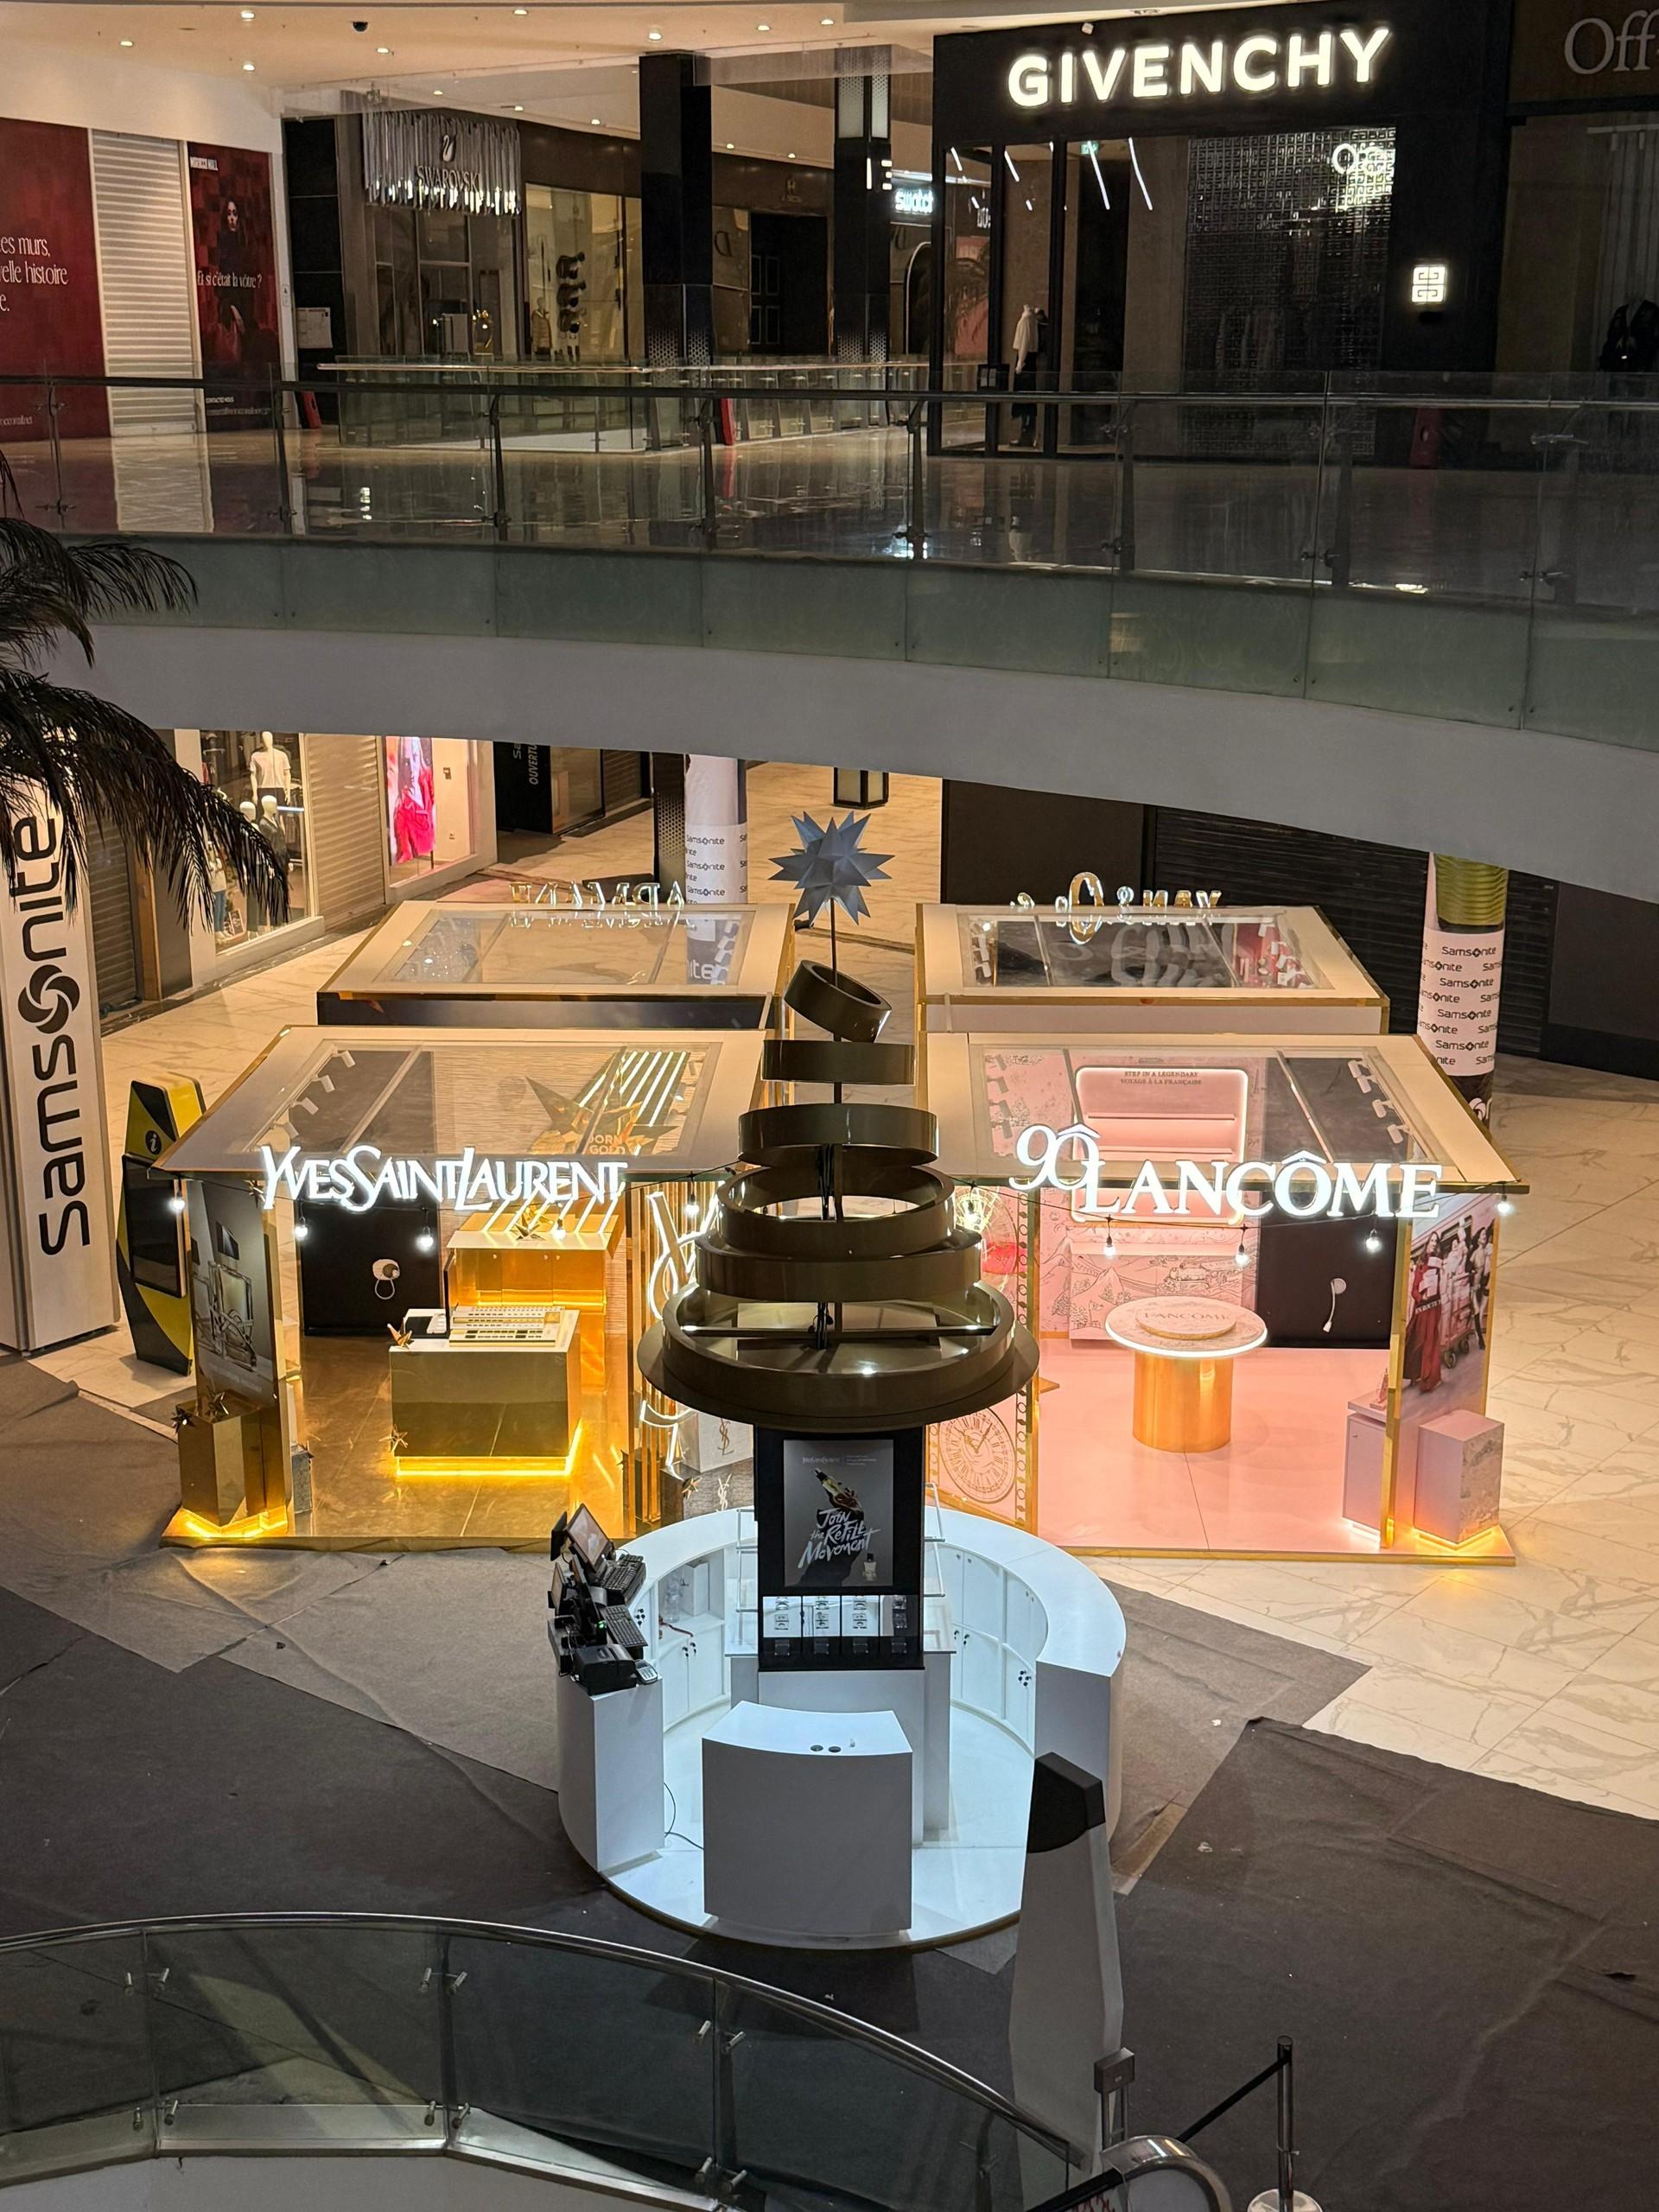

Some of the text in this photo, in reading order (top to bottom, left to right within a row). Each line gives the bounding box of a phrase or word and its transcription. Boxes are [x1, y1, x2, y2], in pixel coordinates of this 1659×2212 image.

[1564, 9, 1659, 75] Off
[1007, 27, 1390, 109] GIVENCHY
[0, 236, 51, 257] es murs,
[0, 259, 69, 285] elle histoire
[686, 835, 725, 845] Samsonite
[687, 860, 725, 871] Samsonite
[687, 885, 725, 897] Samsonite
[1441, 946, 1497, 957] Samsonite
[1440, 977, 1494, 989] Samsonite
[1438, 1008, 1491, 1020] Samsonite
[1436, 1039, 1490, 1052] Samsonite
[1082, 1148, 1442, 1218] LANCÔME
